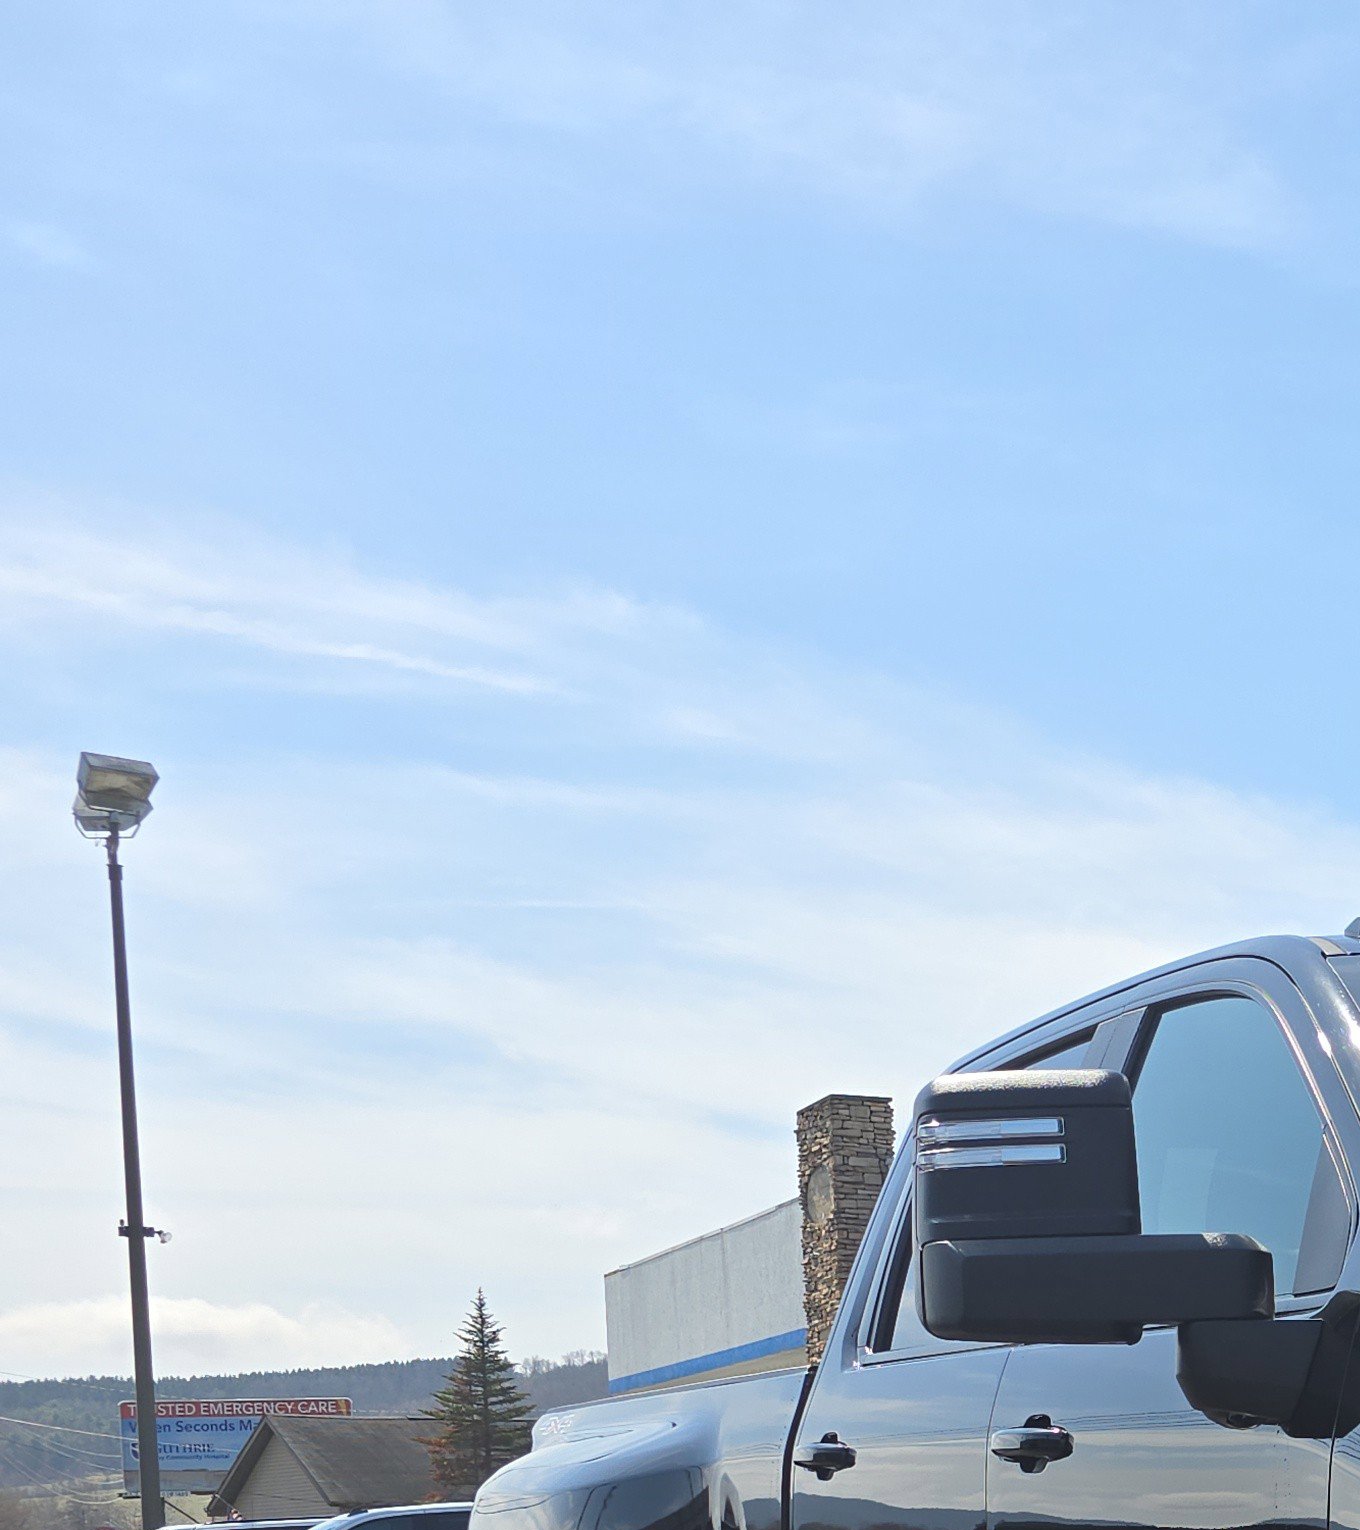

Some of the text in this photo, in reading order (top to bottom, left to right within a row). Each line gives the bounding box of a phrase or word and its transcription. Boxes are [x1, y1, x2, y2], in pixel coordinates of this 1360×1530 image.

[127, 1401, 337, 1416] TSTED EMERGENCY CARE
[129, 1421, 171, 1433] Wen
[175, 1420, 235, 1432] Seconds
